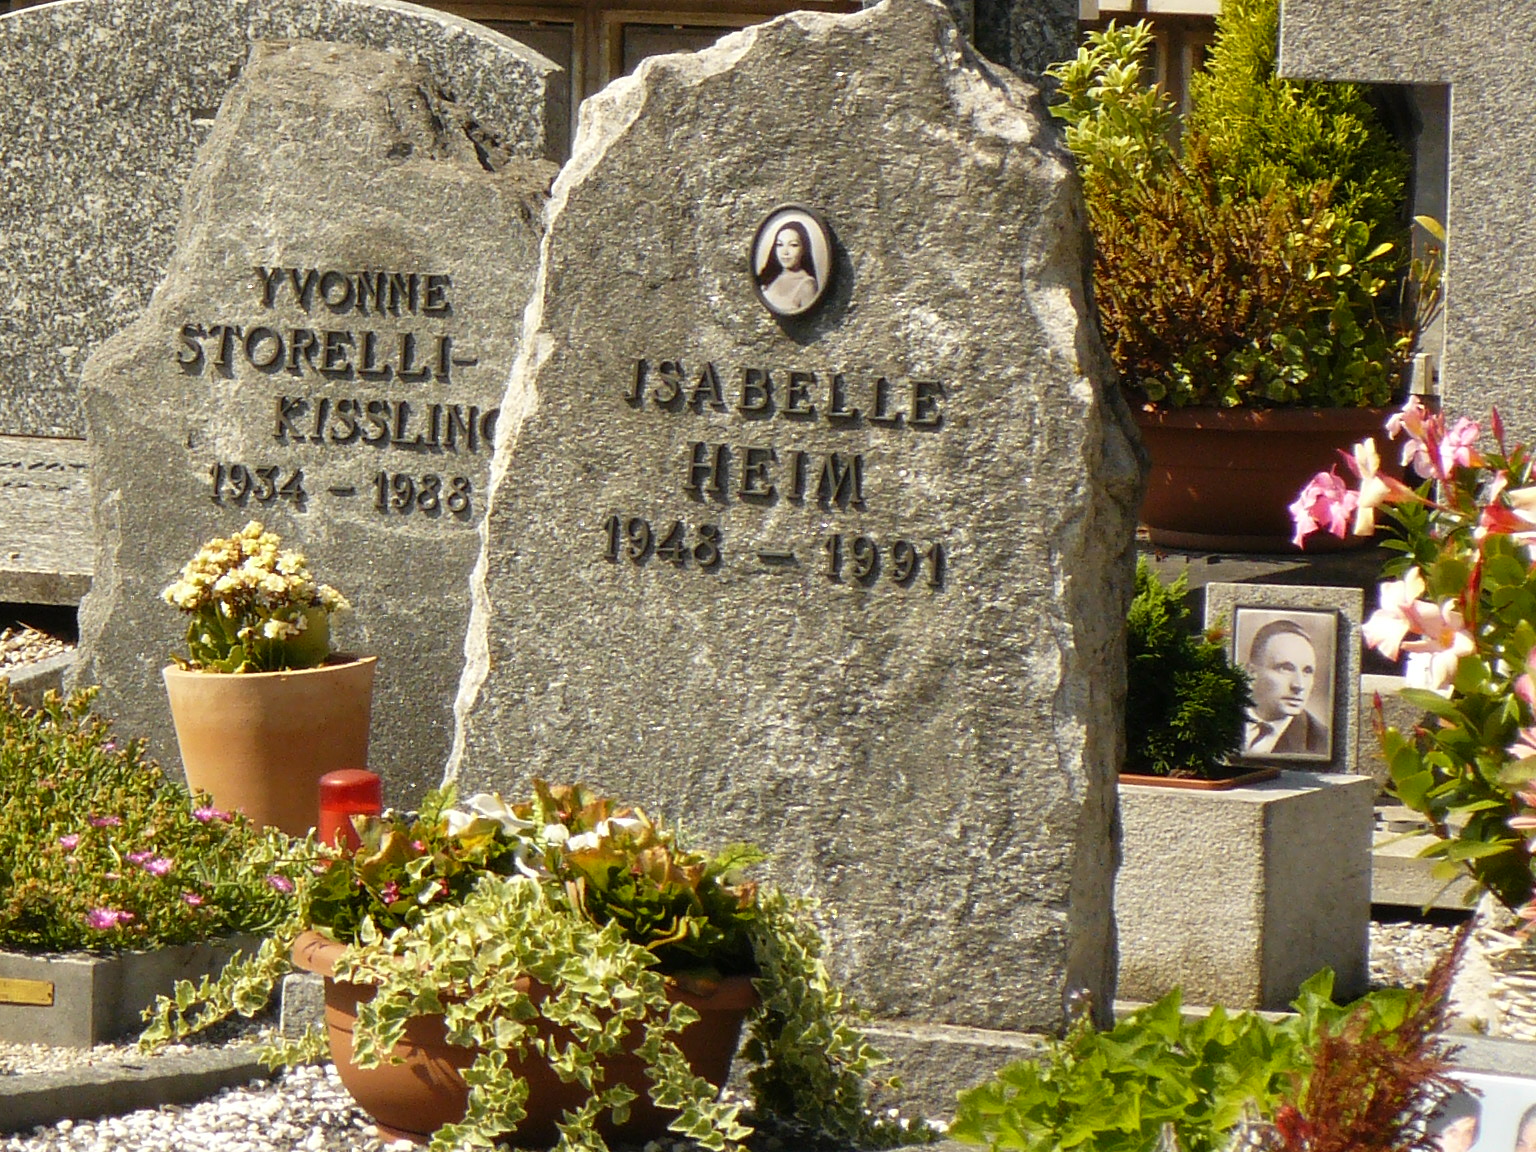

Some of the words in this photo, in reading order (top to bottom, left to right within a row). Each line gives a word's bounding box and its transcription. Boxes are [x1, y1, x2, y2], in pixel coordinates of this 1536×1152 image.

[253, 265, 454, 316] YVONNE
[623, 357, 948, 429] ISABELLE
[209, 461, 309, 512] 1934
[373, 469, 474, 518] 1988
[683, 440, 867, 510] HEIM
[603, 513, 722, 575] 1948
[823, 532, 947, 590] 1991
